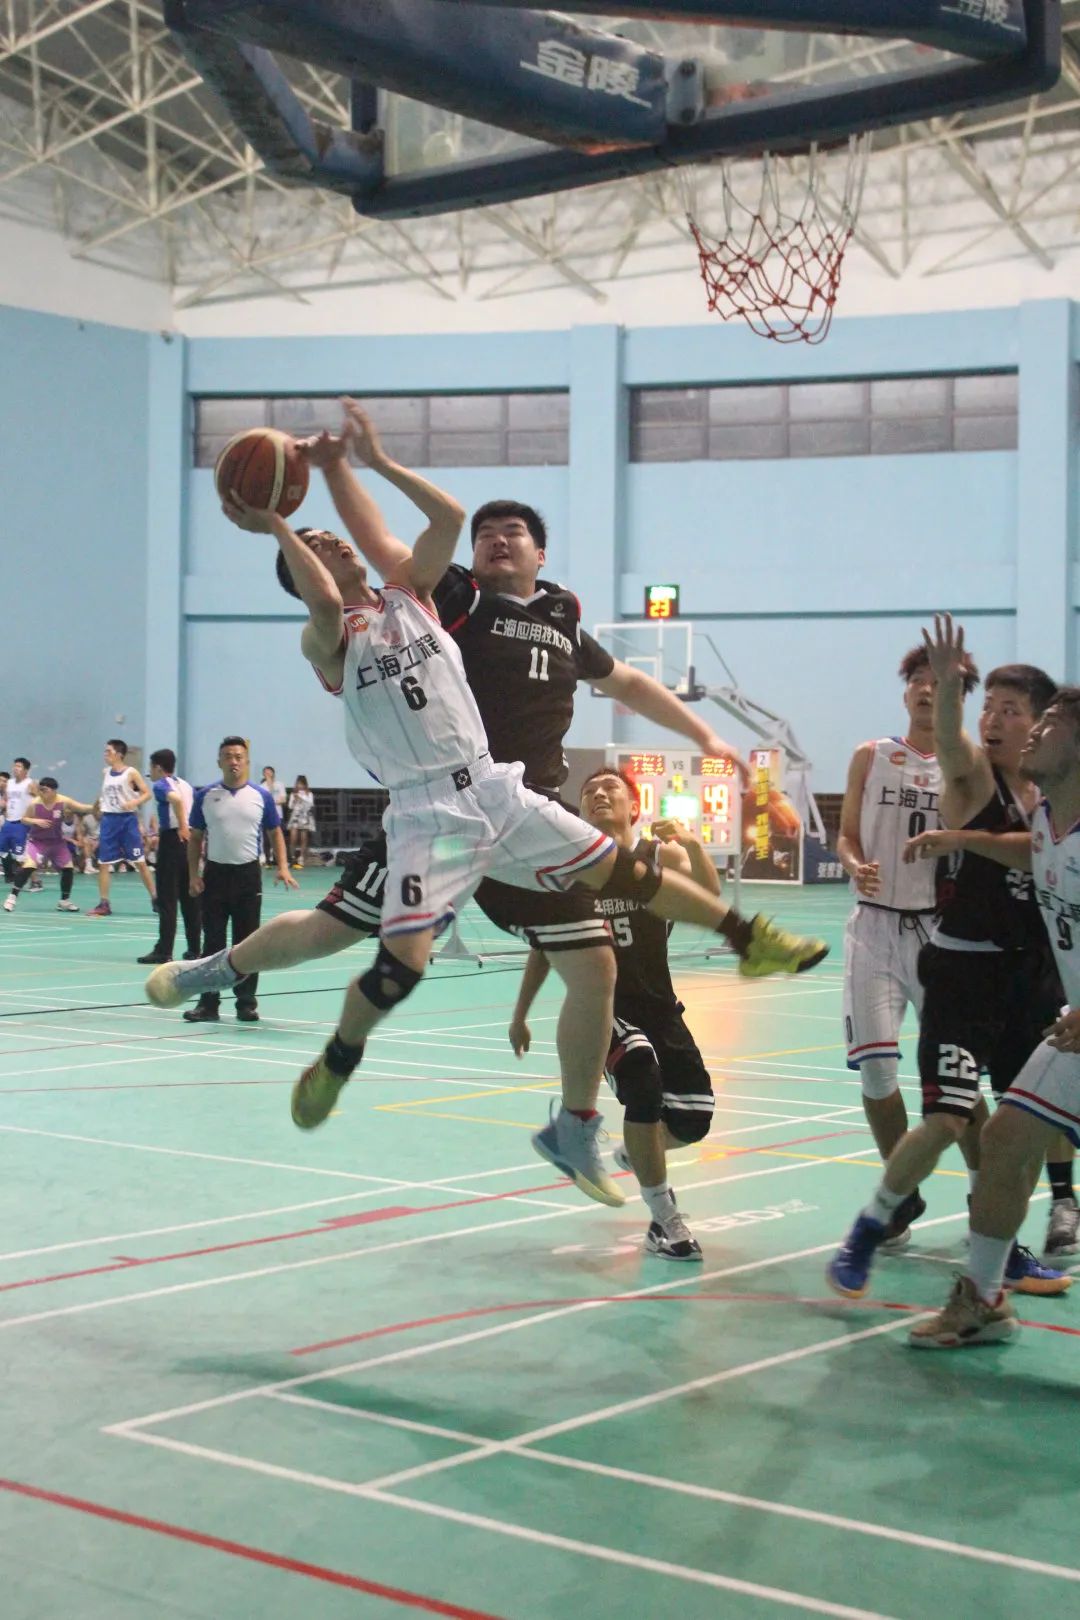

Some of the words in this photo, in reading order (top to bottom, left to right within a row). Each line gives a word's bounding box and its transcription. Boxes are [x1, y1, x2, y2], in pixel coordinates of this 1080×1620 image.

[520, 40, 653, 108] 金陵
[356, 633, 441, 690] 上海工程
[528, 646, 549, 682] 11
[400, 675, 428, 712] 6
[356, 861, 389, 898] 11
[401, 874, 422, 907] 6
[1056, 916, 1073, 951] 9
[937, 1043, 978, 1081] 22
